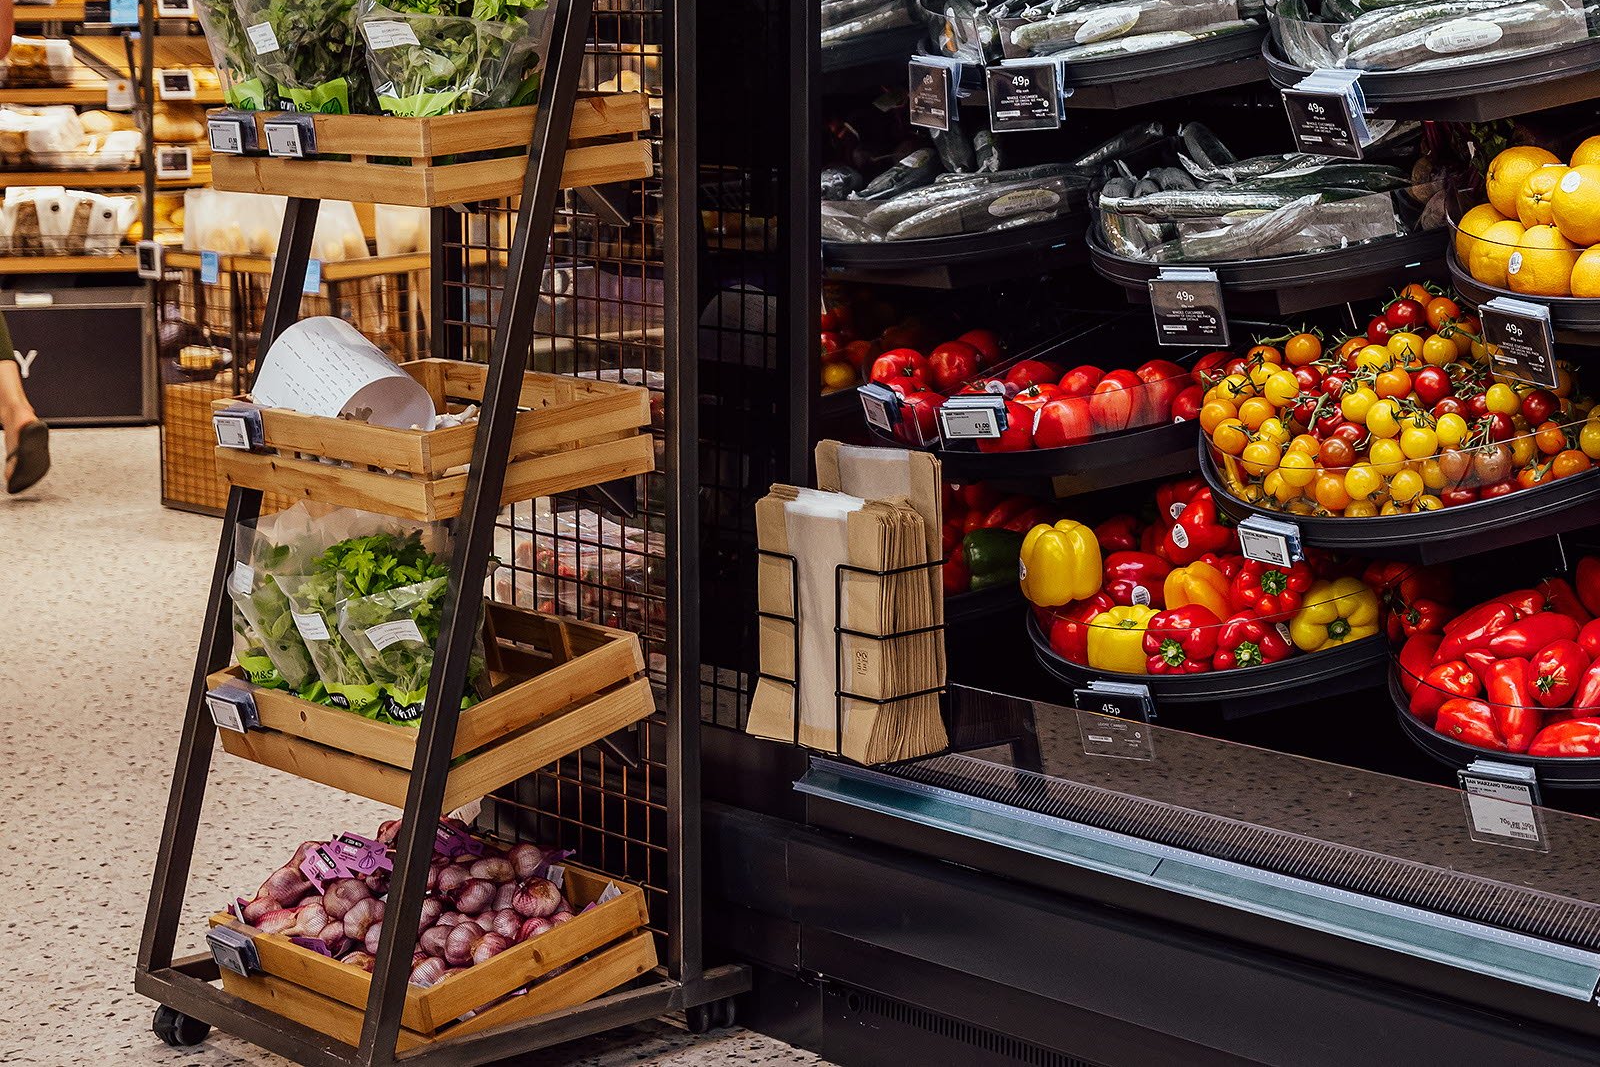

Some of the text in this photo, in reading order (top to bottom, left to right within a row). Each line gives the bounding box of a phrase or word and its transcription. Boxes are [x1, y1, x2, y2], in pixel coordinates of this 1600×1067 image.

[1012, 75, 1030, 86] 49p
[1307, 102, 1325, 114] 49p
[1176, 291, 1195, 302] 49p
[1505, 323, 1523, 336] 49p
[252, 670, 274, 681] M&S
[1102, 703, 1121, 715] 45p
[1500, 782, 1528, 792] TOMATOES
